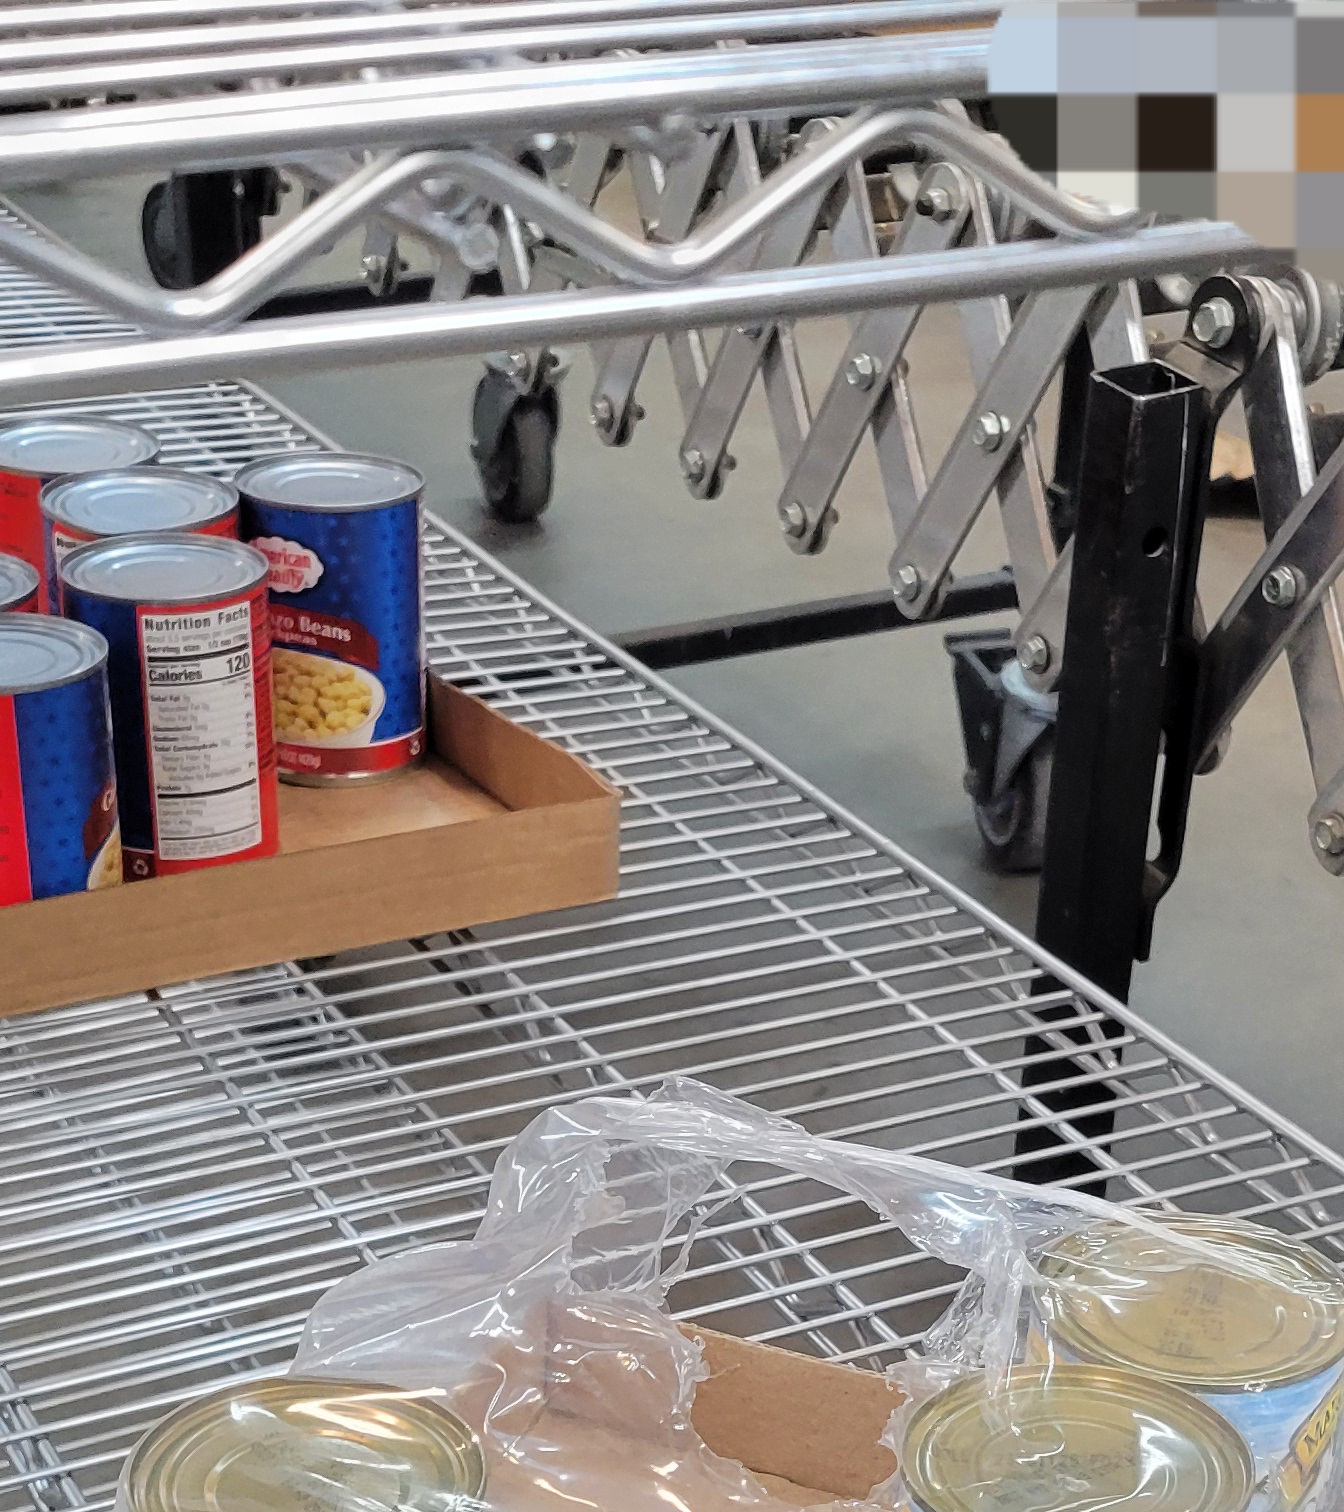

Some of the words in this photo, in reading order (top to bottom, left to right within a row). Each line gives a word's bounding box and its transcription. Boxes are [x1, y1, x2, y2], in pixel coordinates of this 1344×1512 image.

[144, 617, 211, 632] Nutrition
[218, 606, 249, 625] Facts
[300, 616, 351, 642] Beans
[148, 669, 203, 682] Calories
[226, 653, 251, 674] 120
